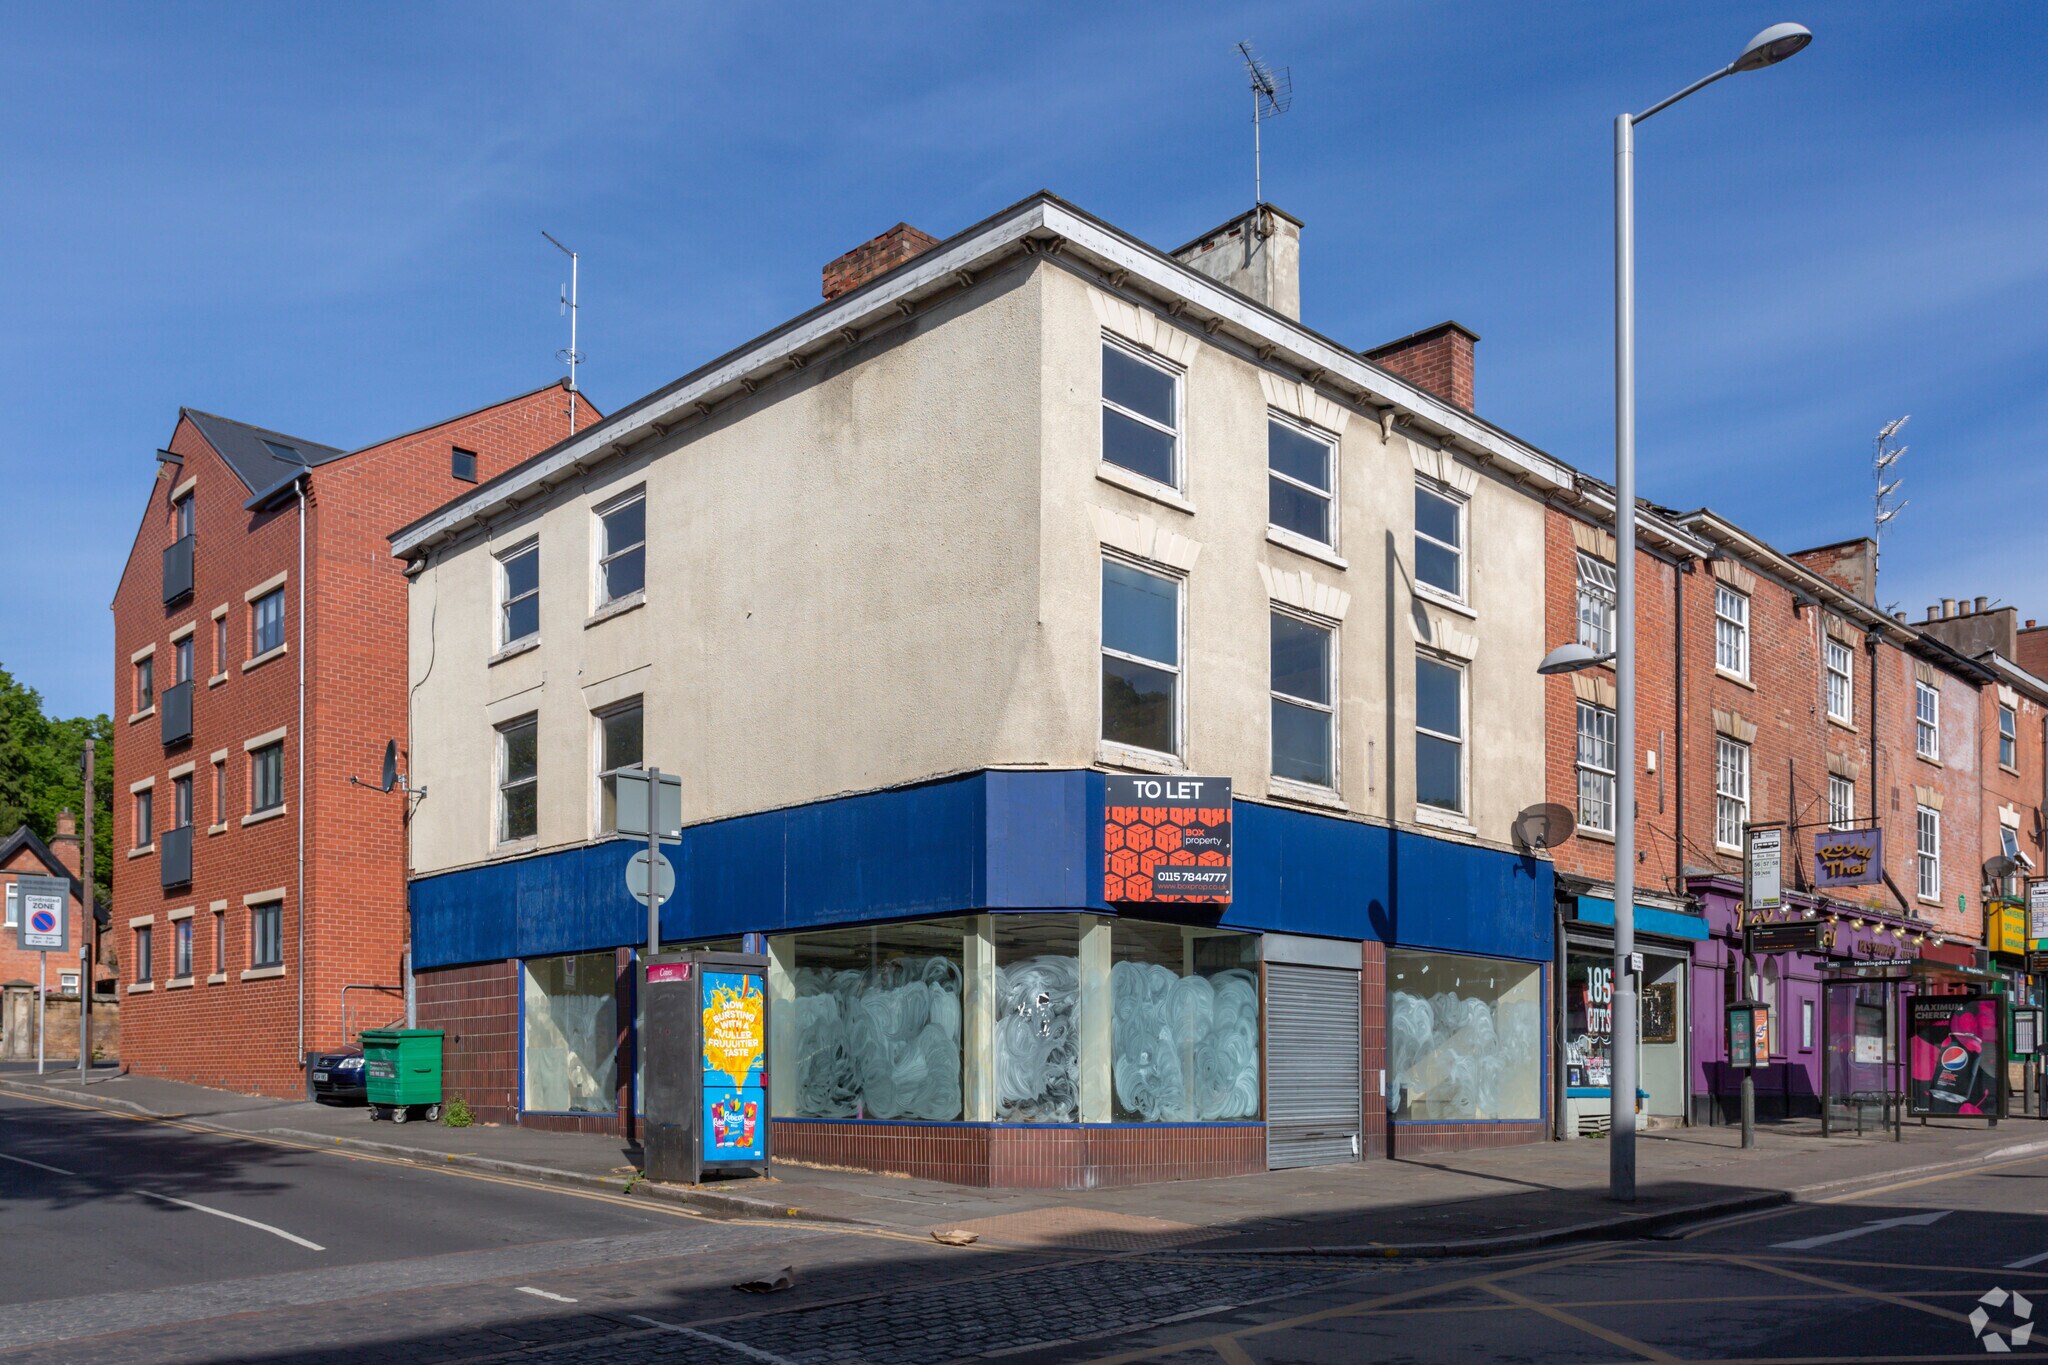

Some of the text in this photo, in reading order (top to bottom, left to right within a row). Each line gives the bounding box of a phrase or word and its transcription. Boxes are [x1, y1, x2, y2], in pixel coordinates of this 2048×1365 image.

[1133, 780, 1204, 799] TO LET
[1185, 828, 1205, 837] BOX
[1185, 837, 1222, 846] property
[1817, 842, 1876, 860] Royal
[1826, 859, 1867, 876] Thai
[1158, 872, 1227, 882] 0115 7844777
[1587, 966, 1611, 1003] 185
[723, 1001, 744, 1010] NOW
[1915, 1003, 1963, 1012] MAXIMUM
[713, 1010, 755, 1023] BURSTING
[1587, 1007, 1611, 1033] CUTS
[1915, 1011, 1951, 1019] CHERRY
[720, 1020, 749, 1030] WITH A
[714, 1028, 752, 1039] FUULLER
[723, 1048, 749, 1057] TASTE
[724, 1110, 744, 1123] Rubicon
